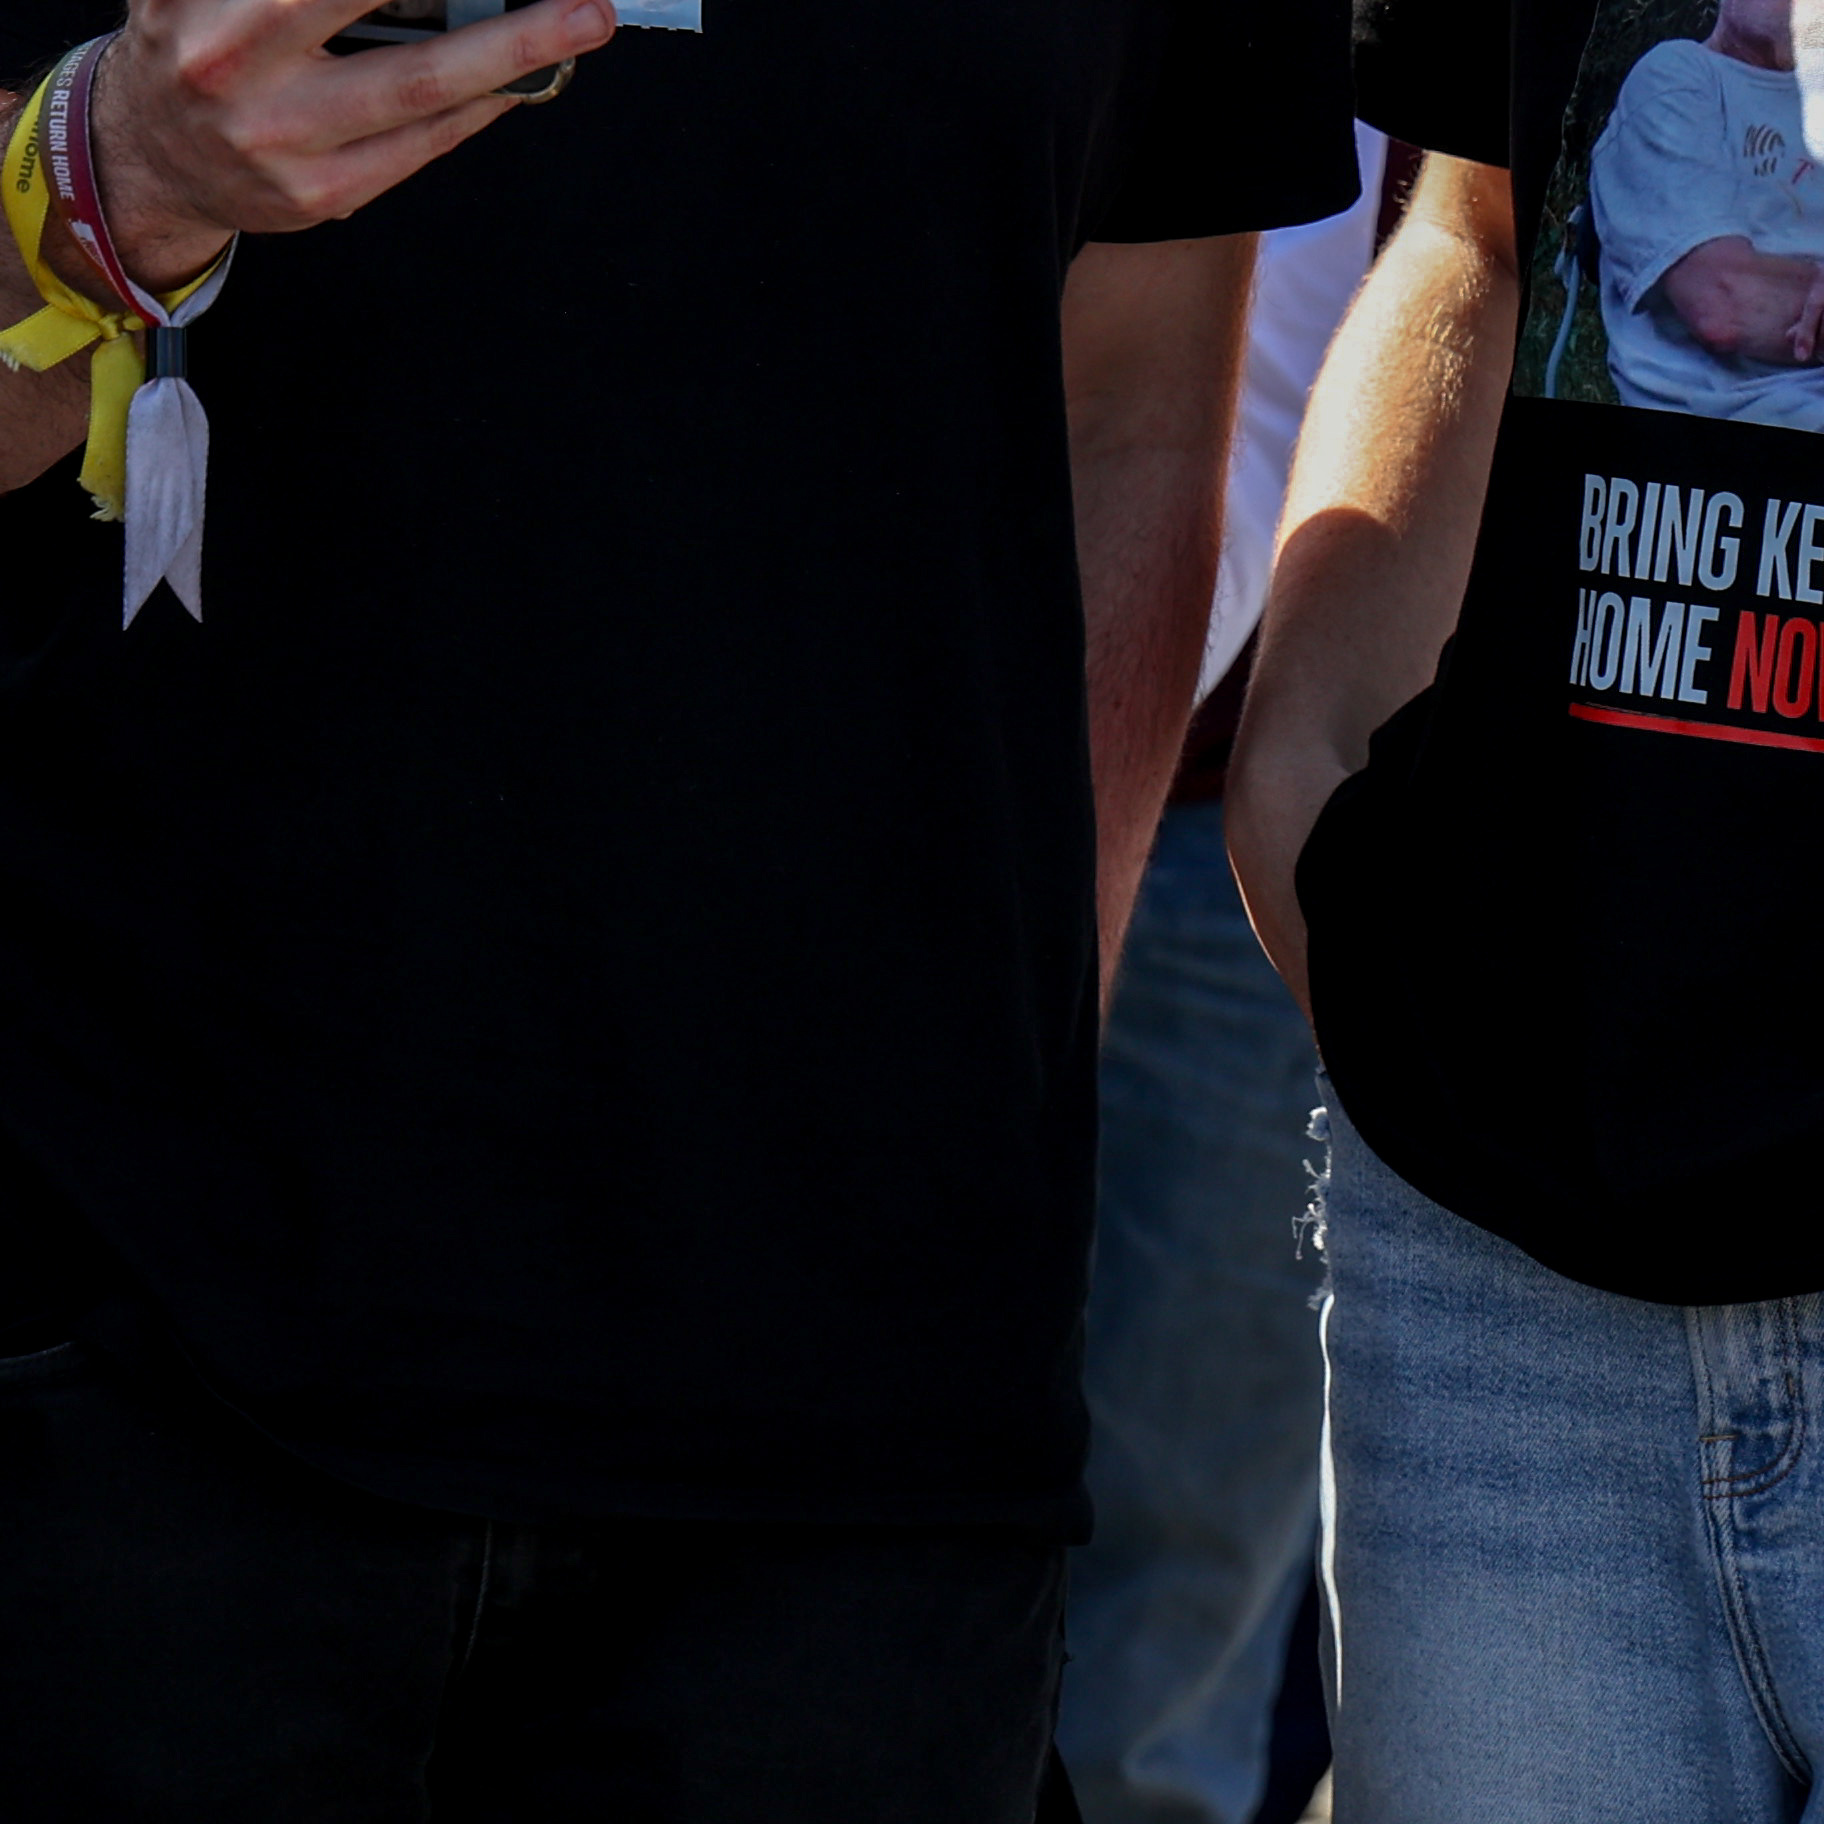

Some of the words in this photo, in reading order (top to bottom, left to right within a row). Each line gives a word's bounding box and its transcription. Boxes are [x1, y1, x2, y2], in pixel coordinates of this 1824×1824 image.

[48, 90, 71, 152] RETURN
[52, 155, 75, 202] HOME
[1579, 473, 1744, 593] BRING
[1570, 587, 1720, 705] HOME
